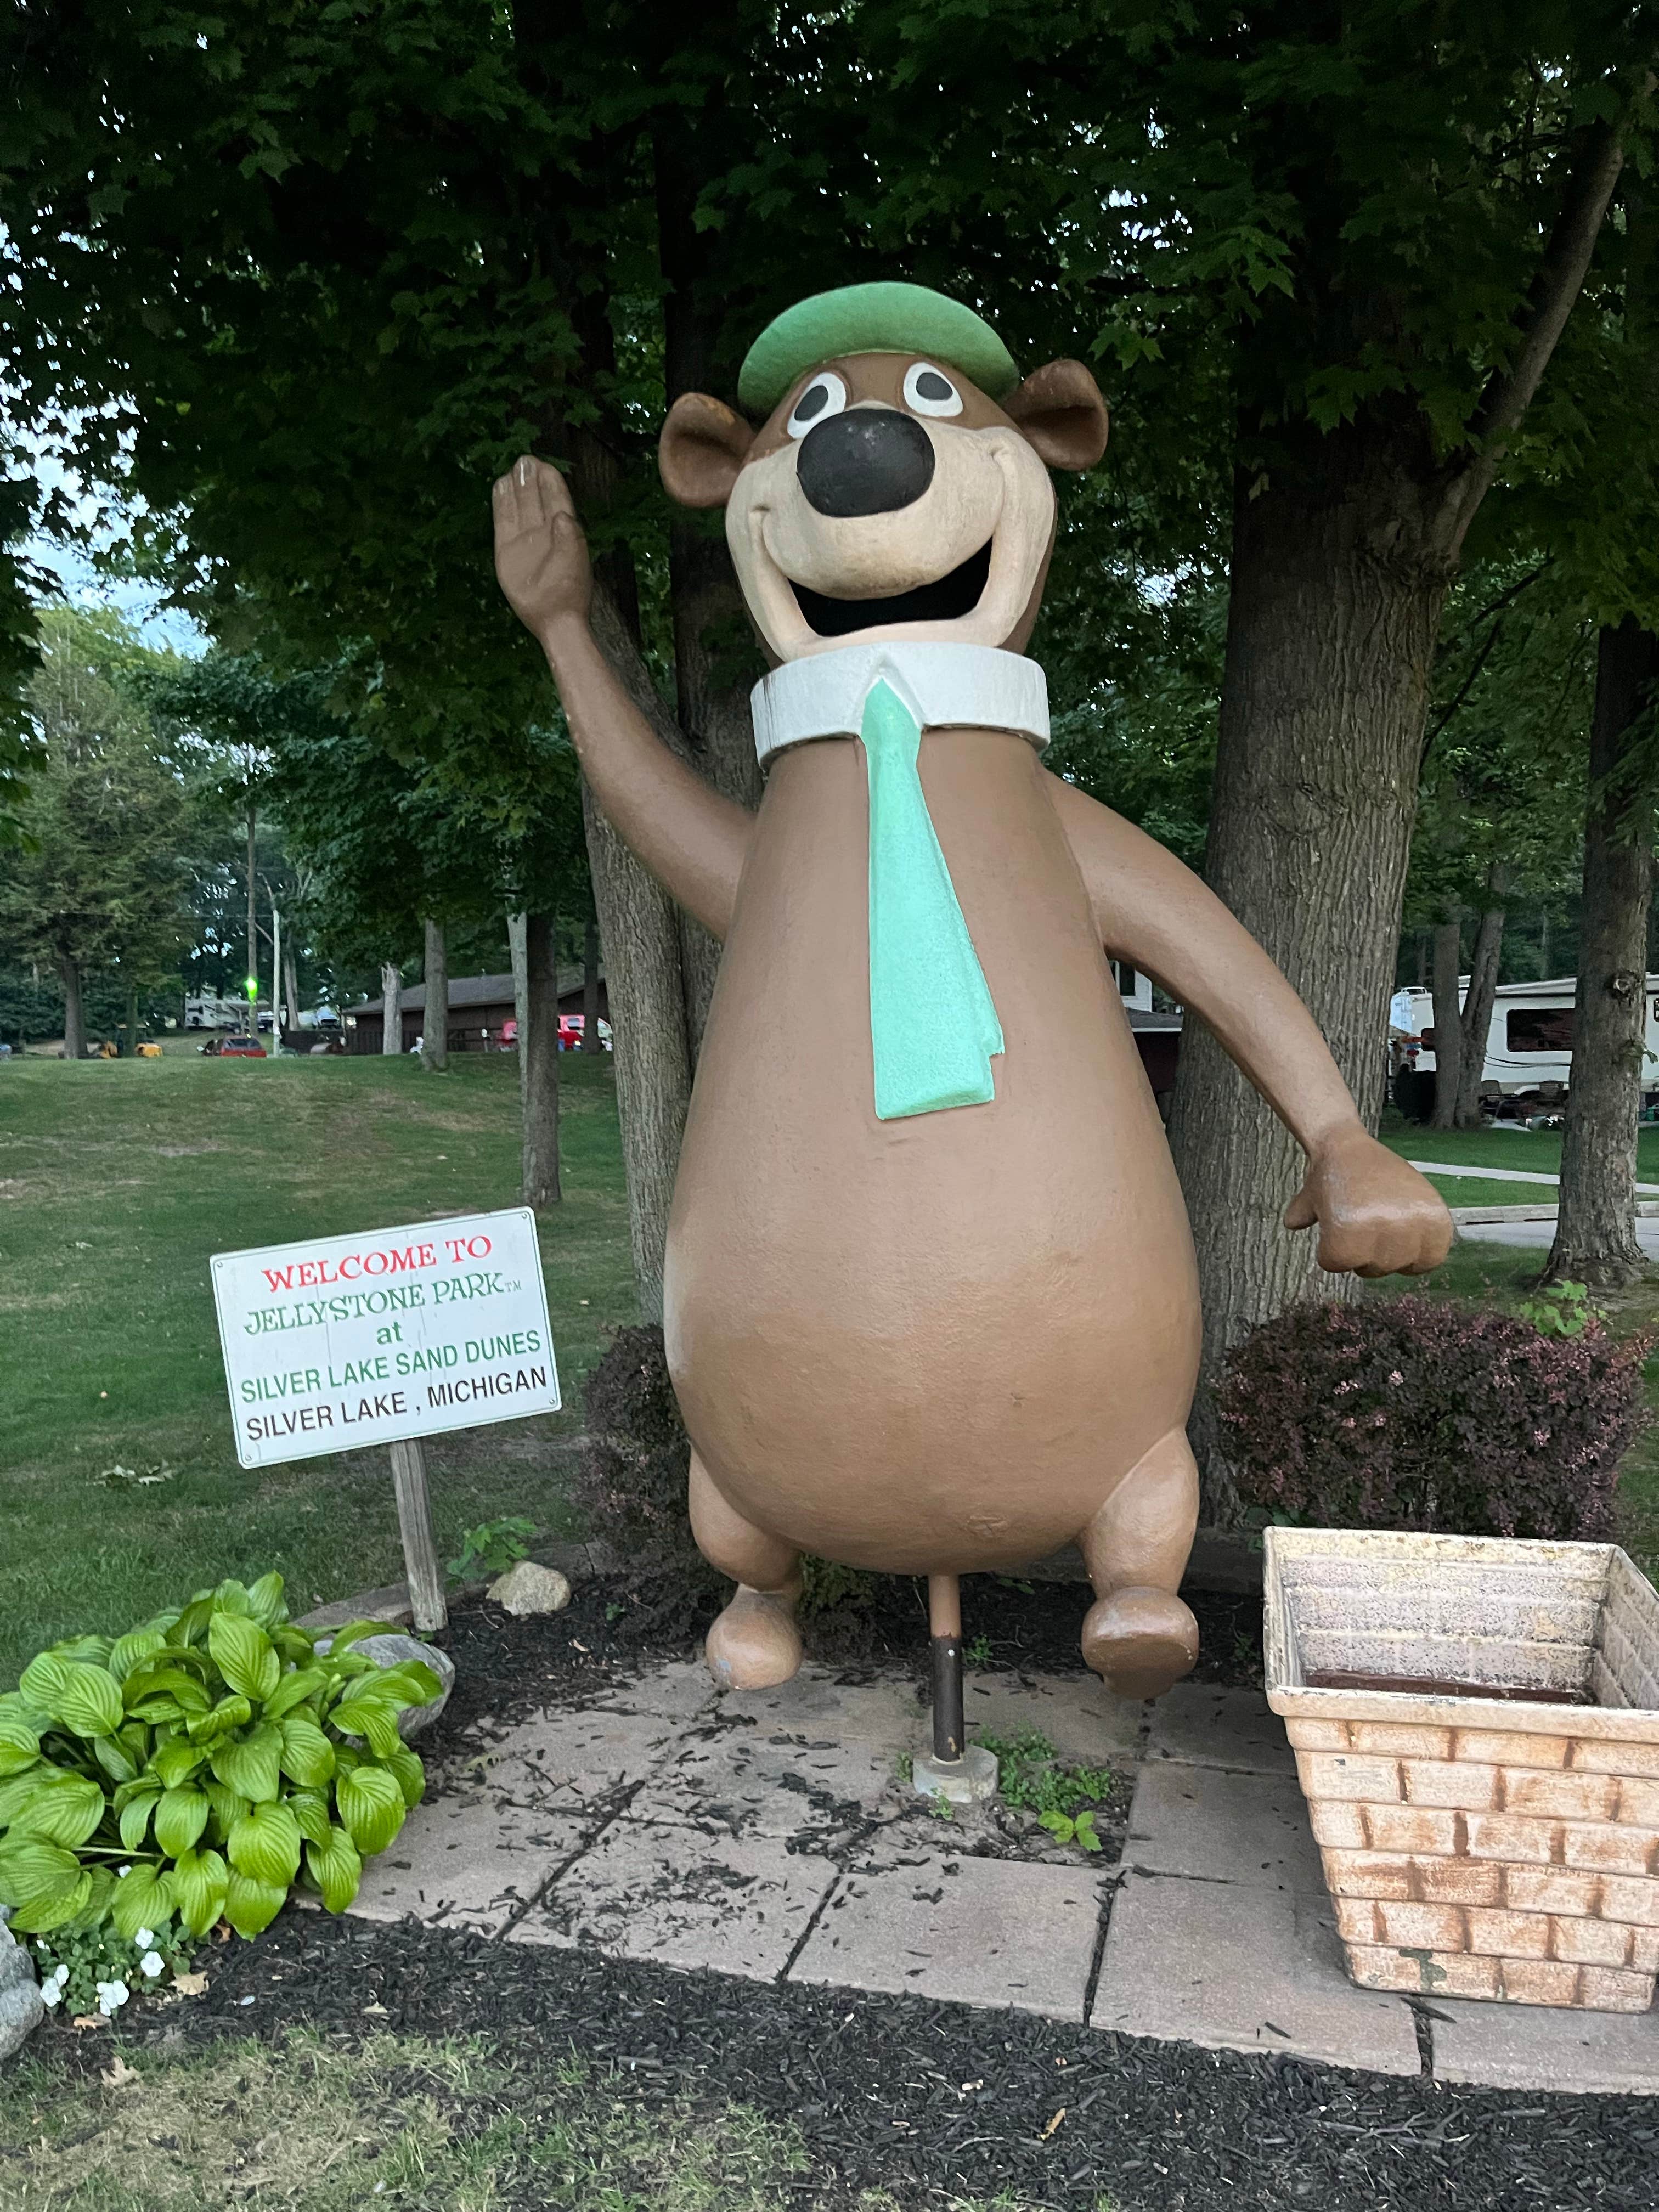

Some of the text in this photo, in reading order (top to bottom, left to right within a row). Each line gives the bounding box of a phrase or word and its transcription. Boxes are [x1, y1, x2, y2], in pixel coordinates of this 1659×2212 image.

[262, 1235, 492, 1292] WELCOME TO
[244, 1283, 426, 1335] JELLYSTONE
[376, 1321, 403, 1345] at
[241, 1330, 540, 1403] SILVER LAKE SAND DUNES
[247, 1406, 333, 1441] SILVER
[428, 1367, 548, 1408] MICHIGAN
